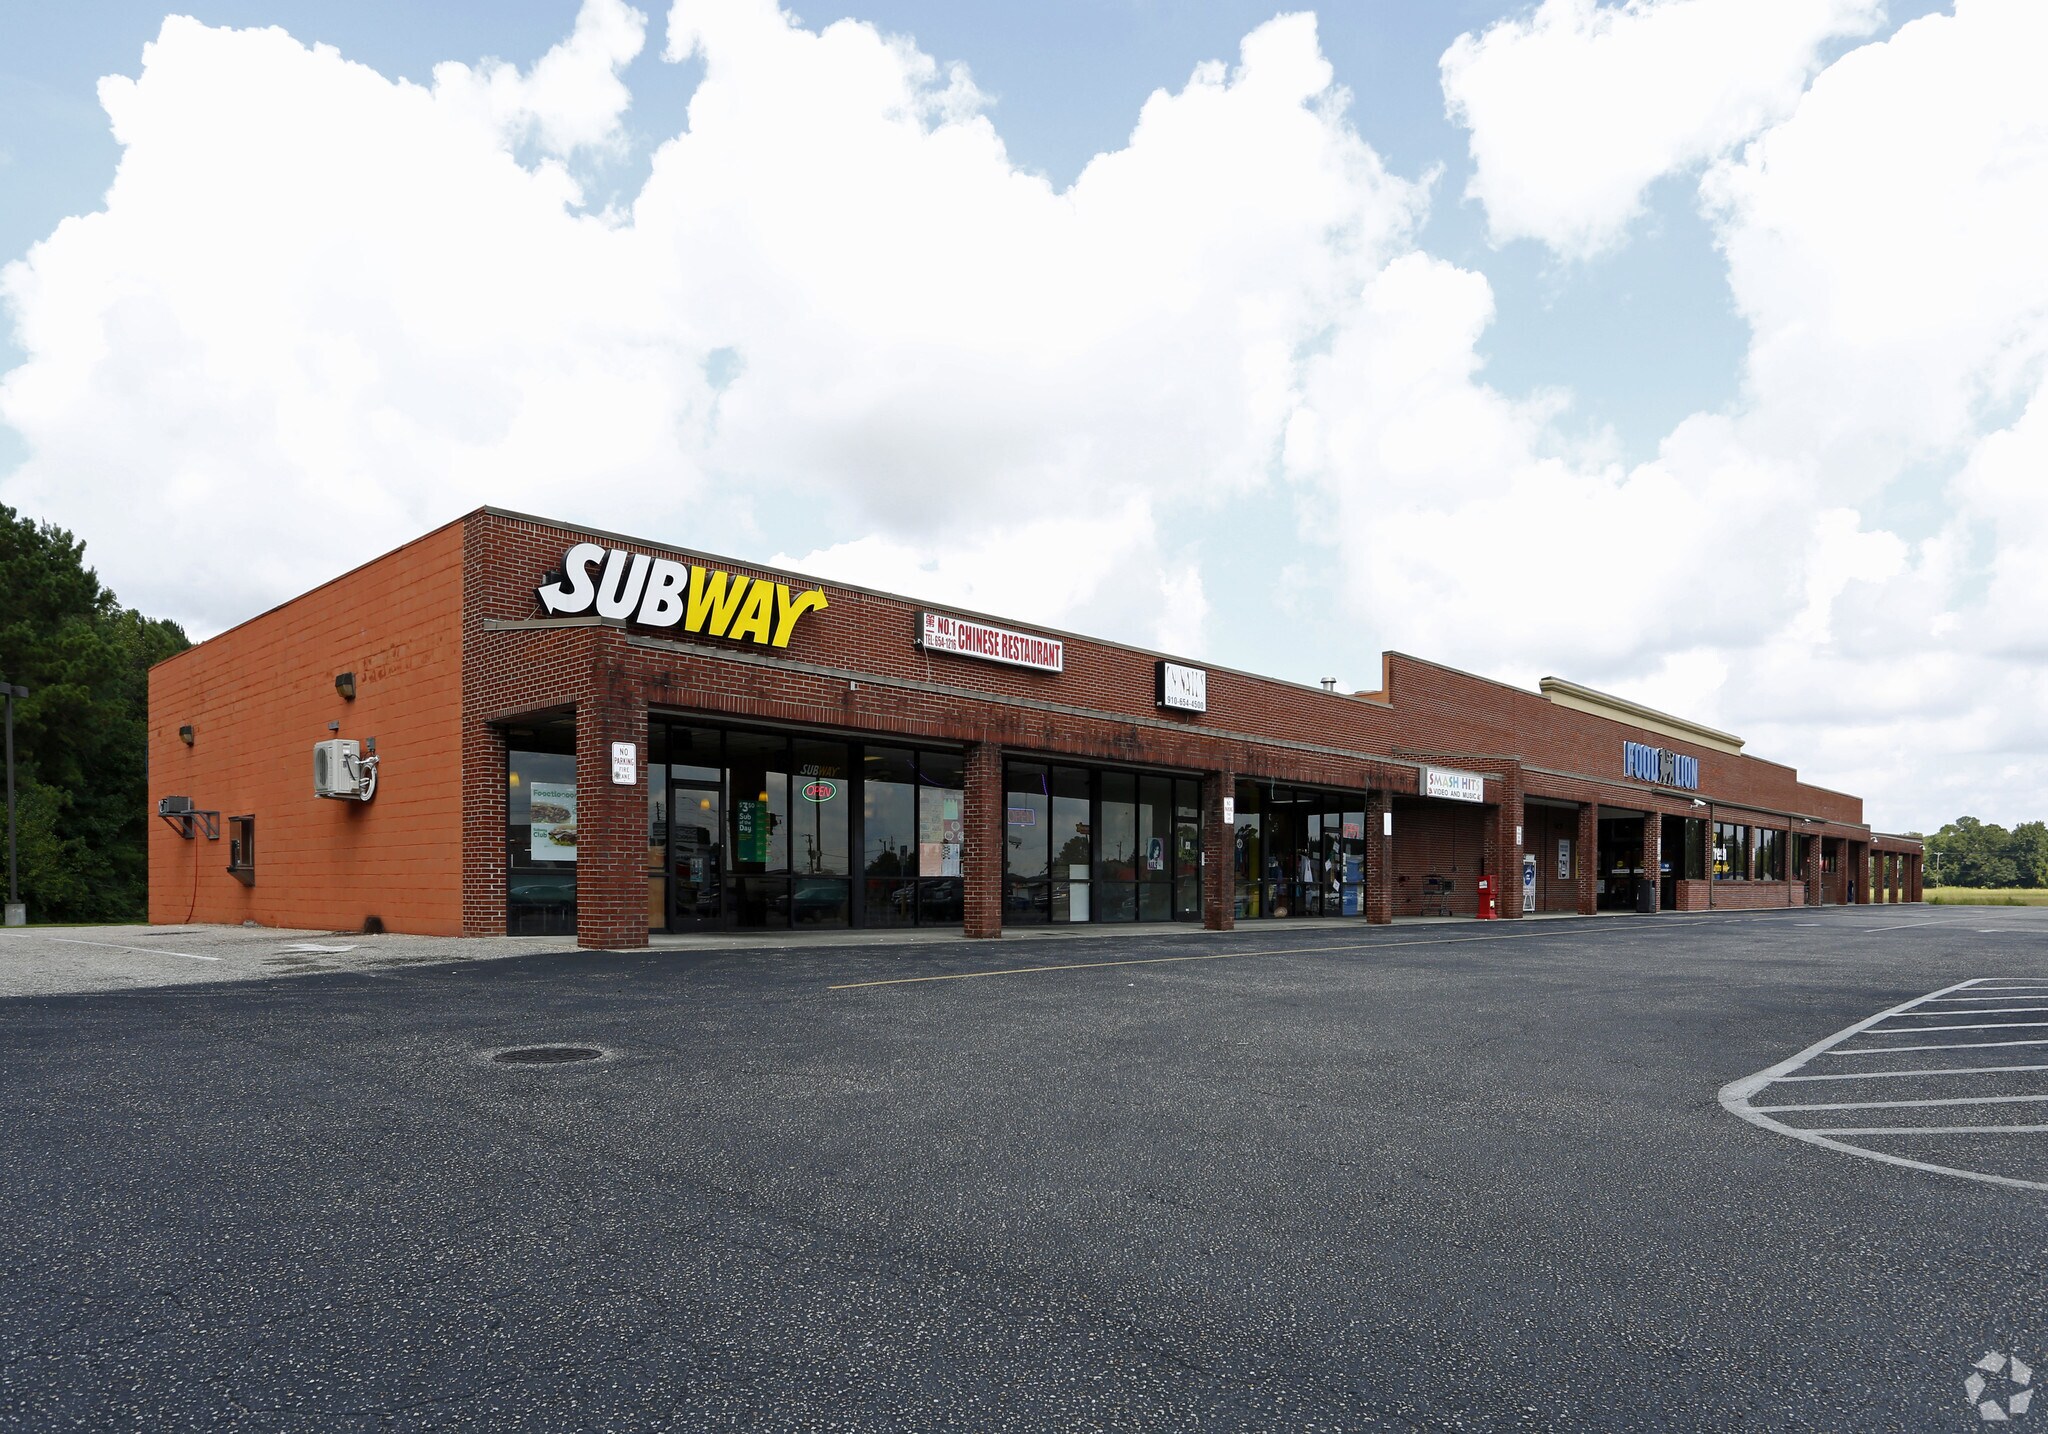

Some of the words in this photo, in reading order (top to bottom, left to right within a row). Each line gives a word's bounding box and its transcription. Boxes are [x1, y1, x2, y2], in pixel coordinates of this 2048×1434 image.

[537, 541, 829, 648] SUBWAY
[937, 617, 956, 637] NO.1
[958, 623, 1000, 657] CHINESE
[1001, 633, 1061, 668] RESTAURANT
[1167, 695, 1204, 710] 910-654-4500
[619, 748, 629, 756] NO
[614, 757, 634, 766] PARKING
[1623, 741, 1660, 784] FOOD
[1674, 753, 1698, 791] LION
[800, 764, 839, 777] SUBWAY
[1429, 772, 1460, 789] SMASH
[1461, 777, 1481, 791] HITS
[806, 785, 832, 797] OPEN
[1433, 788, 1449, 797] VIDEO
[1450, 790, 1461, 798] AND
[1462, 791, 1477, 800] MUSIC
[739, 812, 752, 820] Sub
[739, 825, 752, 834] Day
